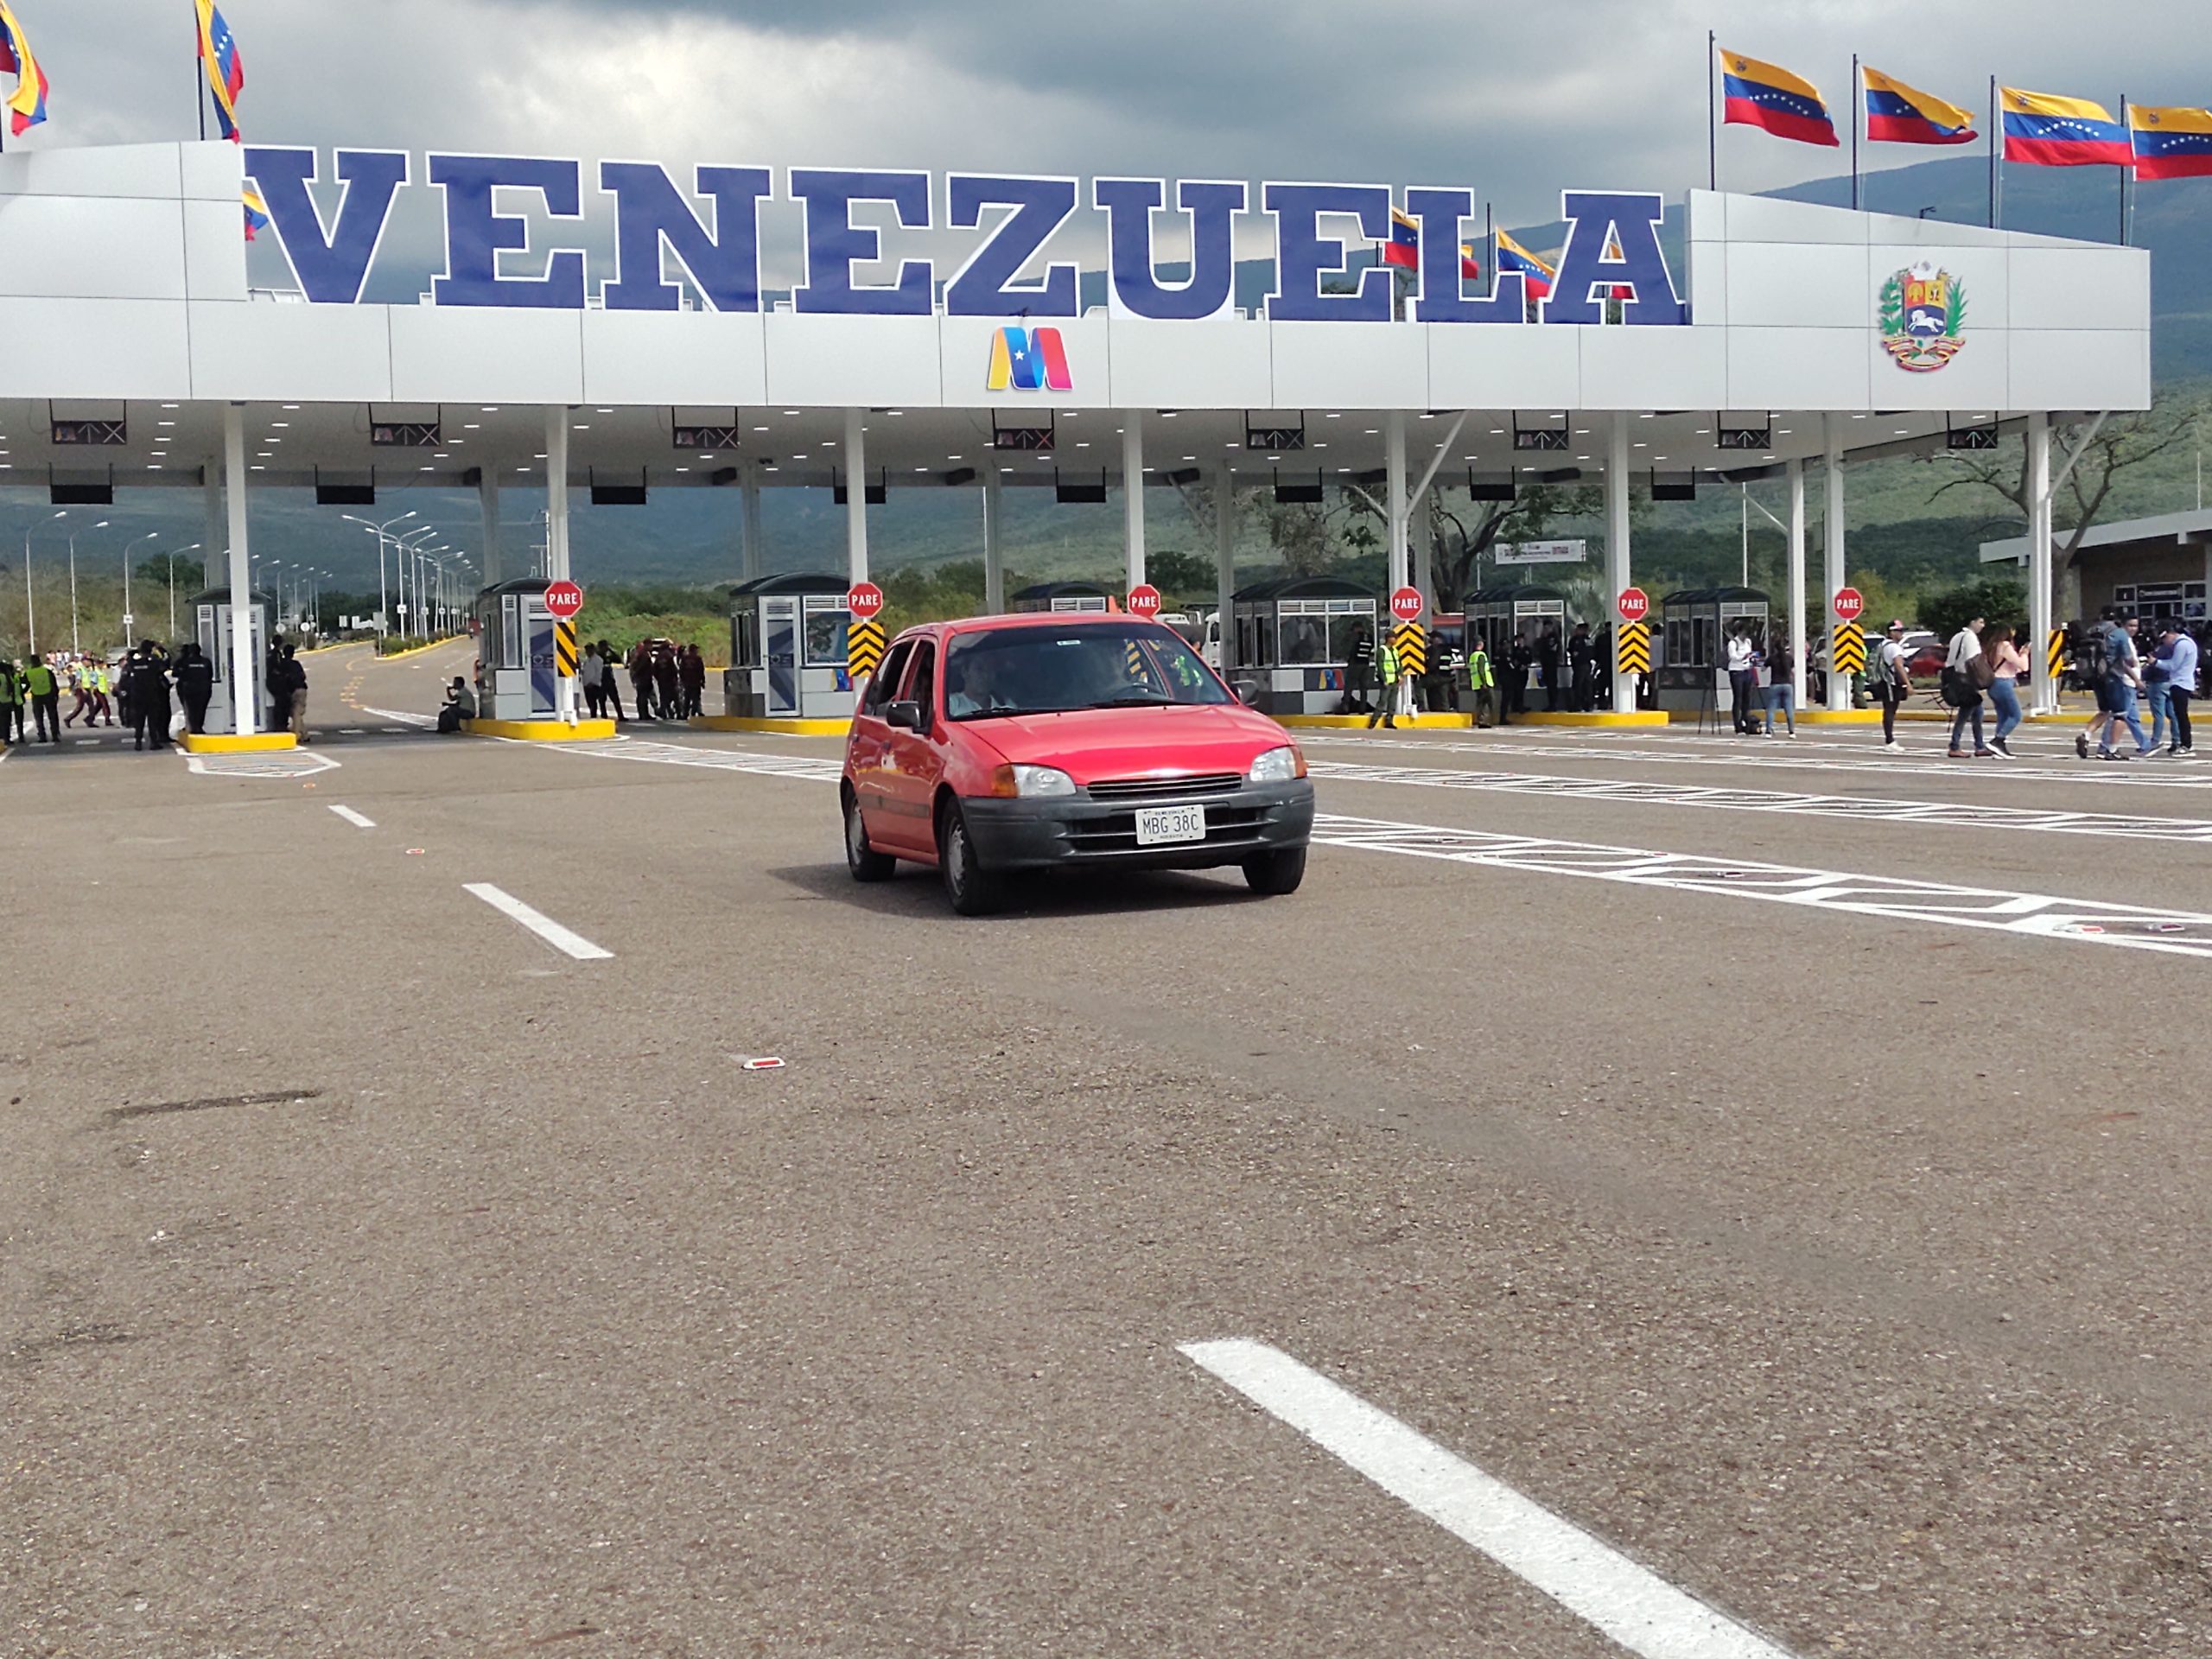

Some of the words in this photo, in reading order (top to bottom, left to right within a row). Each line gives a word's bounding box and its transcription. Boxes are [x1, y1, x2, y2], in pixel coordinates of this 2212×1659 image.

[241, 144, 1691, 327] VENEZUELA
[549, 593, 577, 605] PARE
[851, 594, 878, 607] PARE
[1131, 596, 1156, 607] PARE
[1394, 598, 1418, 609] PARE
[1621, 599, 1644, 609] PARE
[1836, 599, 1859, 609] PARE
[1142, 817, 1168, 835] MBG
[1173, 814, 1198, 832] 38C
